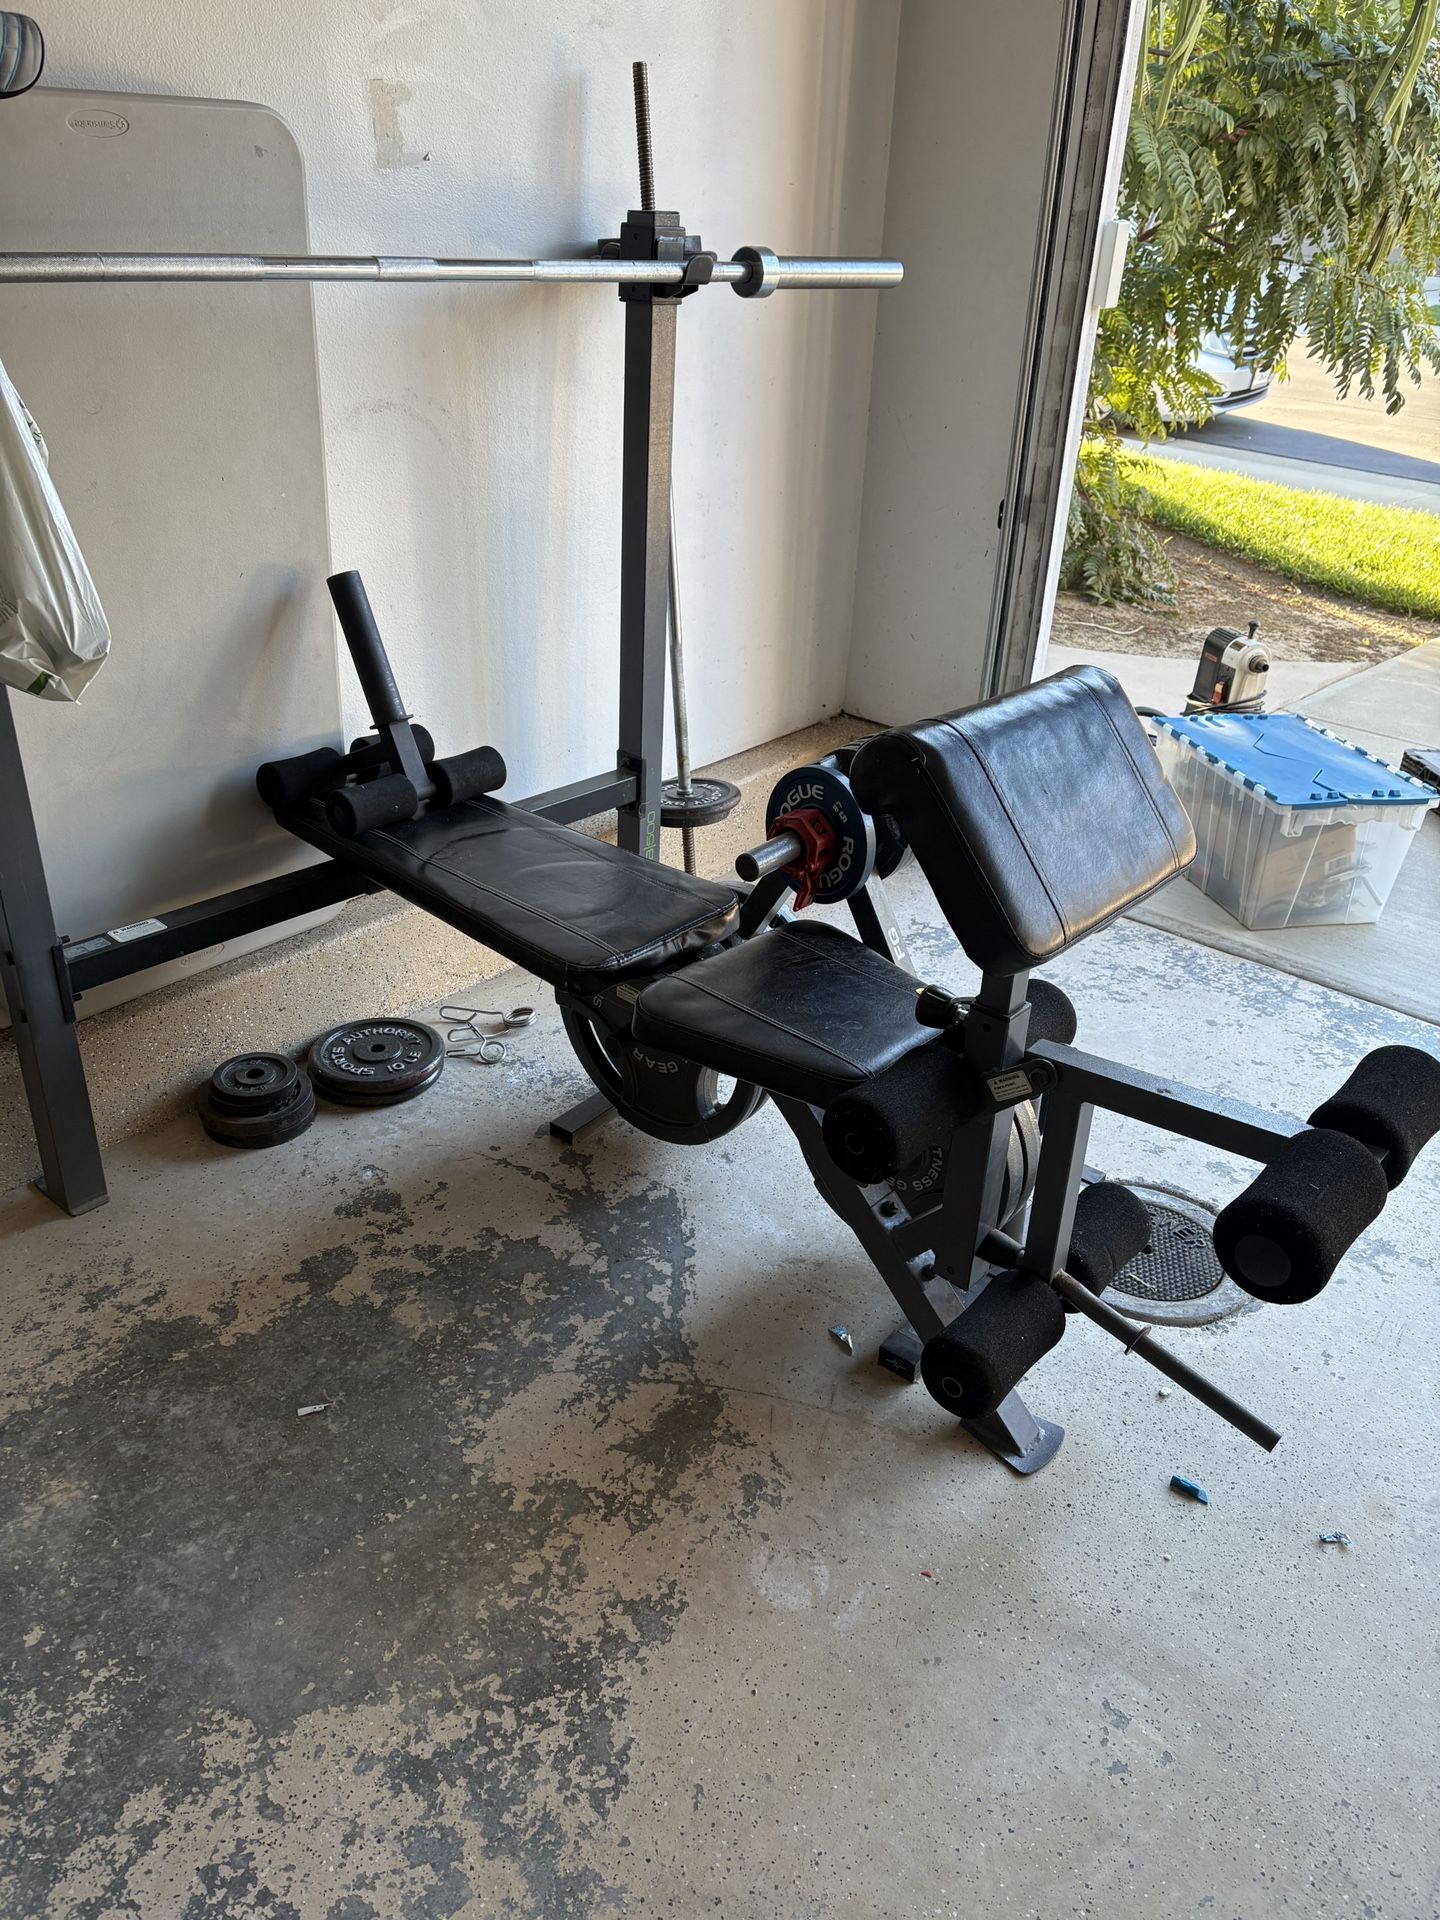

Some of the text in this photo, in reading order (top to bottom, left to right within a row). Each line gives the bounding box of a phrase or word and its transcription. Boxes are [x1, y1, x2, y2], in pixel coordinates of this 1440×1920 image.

[780, 784, 824, 816] OGUE
[819, 836, 854, 888] ROGU
[888, 927, 905, 960] FG
[331, 1027, 422, 1075] SPORTS AUTHORITY
[387, 1062, 405, 1072] 10
[632, 1048, 679, 1073] GEAR
[912, 1147, 942, 1190] TNESS
[1154, 1211, 1206, 1247] WER
